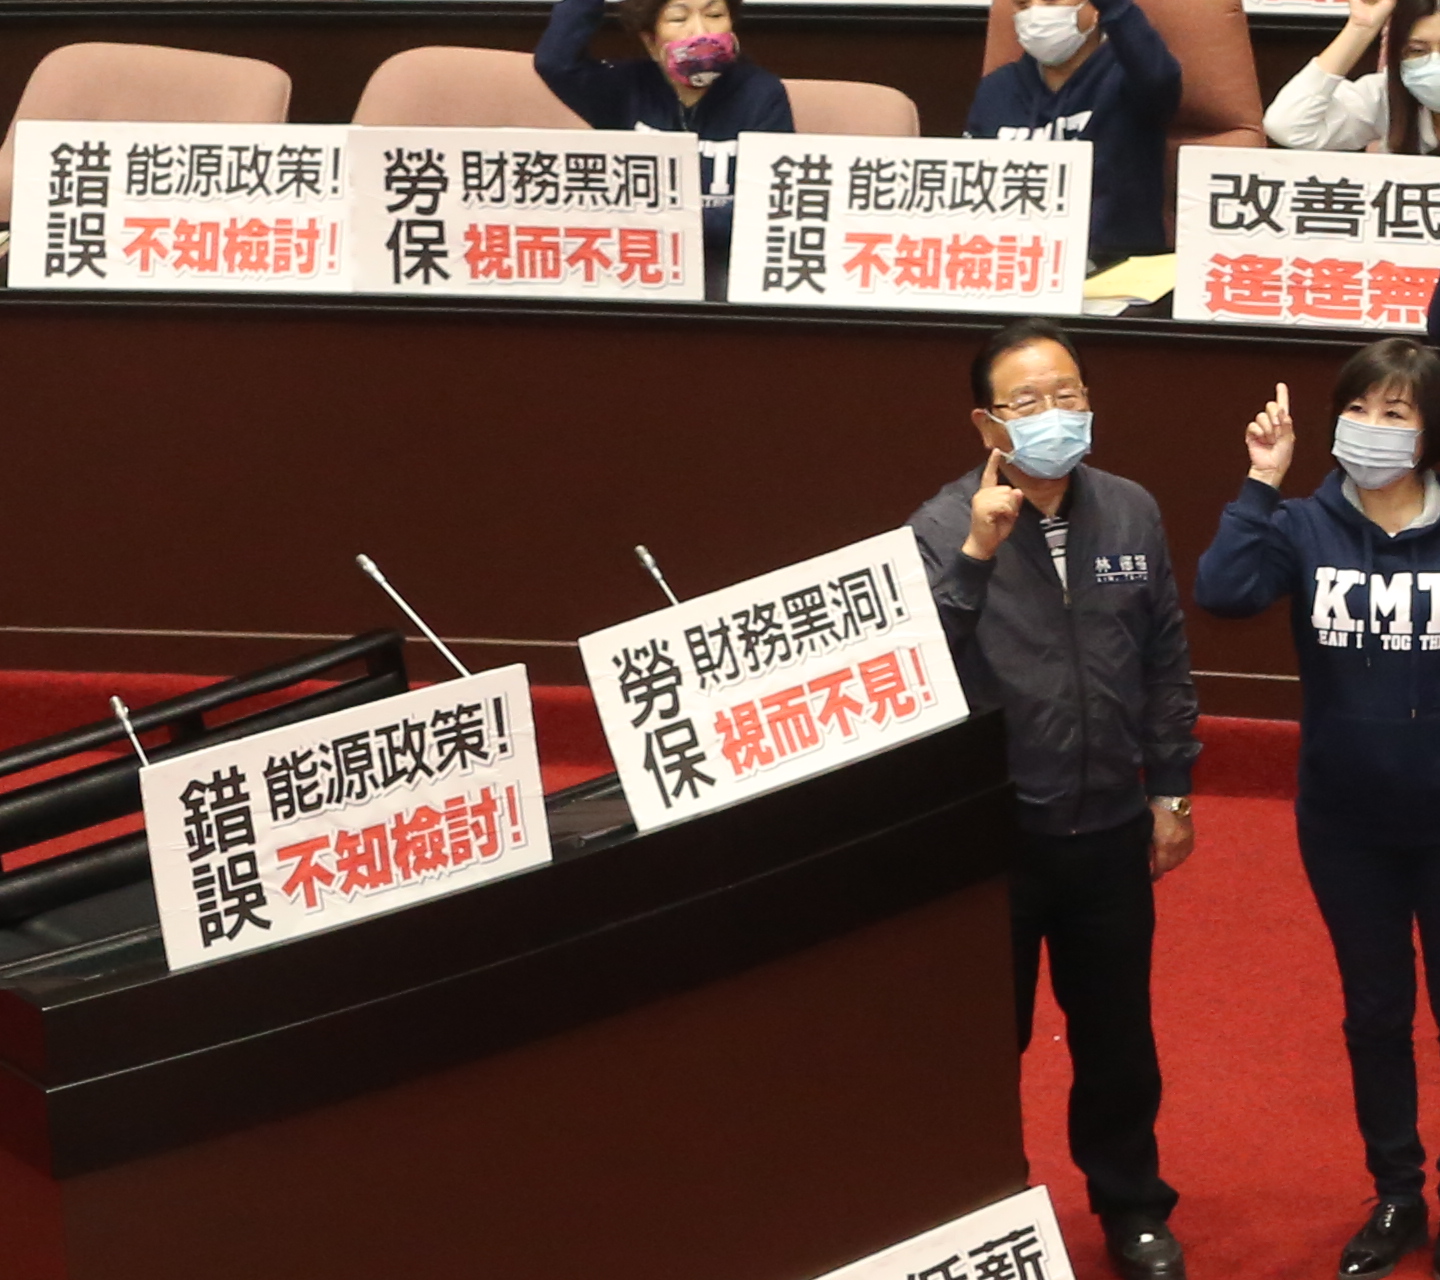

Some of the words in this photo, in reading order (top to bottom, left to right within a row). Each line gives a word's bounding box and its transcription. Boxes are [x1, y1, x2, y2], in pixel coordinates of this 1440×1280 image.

[45, 140, 111, 279] 錯誤
[126, 141, 342, 198] 能源政策!
[384, 146, 449, 286] 勞保
[461, 151, 679, 210] 財務黑洞!
[763, 154, 832, 293] 錯誤
[847, 156, 1067, 216] 能源政策!
[122, 216, 339, 276] 不知檢討!
[464, 221, 683, 285] 視而不見!
[842, 231, 1063, 295] 不知檢討!
[684, 563, 904, 691] 財務黑洞!
[262, 696, 511, 823] 能源政策!
[611, 639, 716, 809] 勞保
[712, 647, 933, 776] 視而不見!
[178, 767, 272, 948] 錯誤
[276, 785, 522, 911] 不知檢討!
